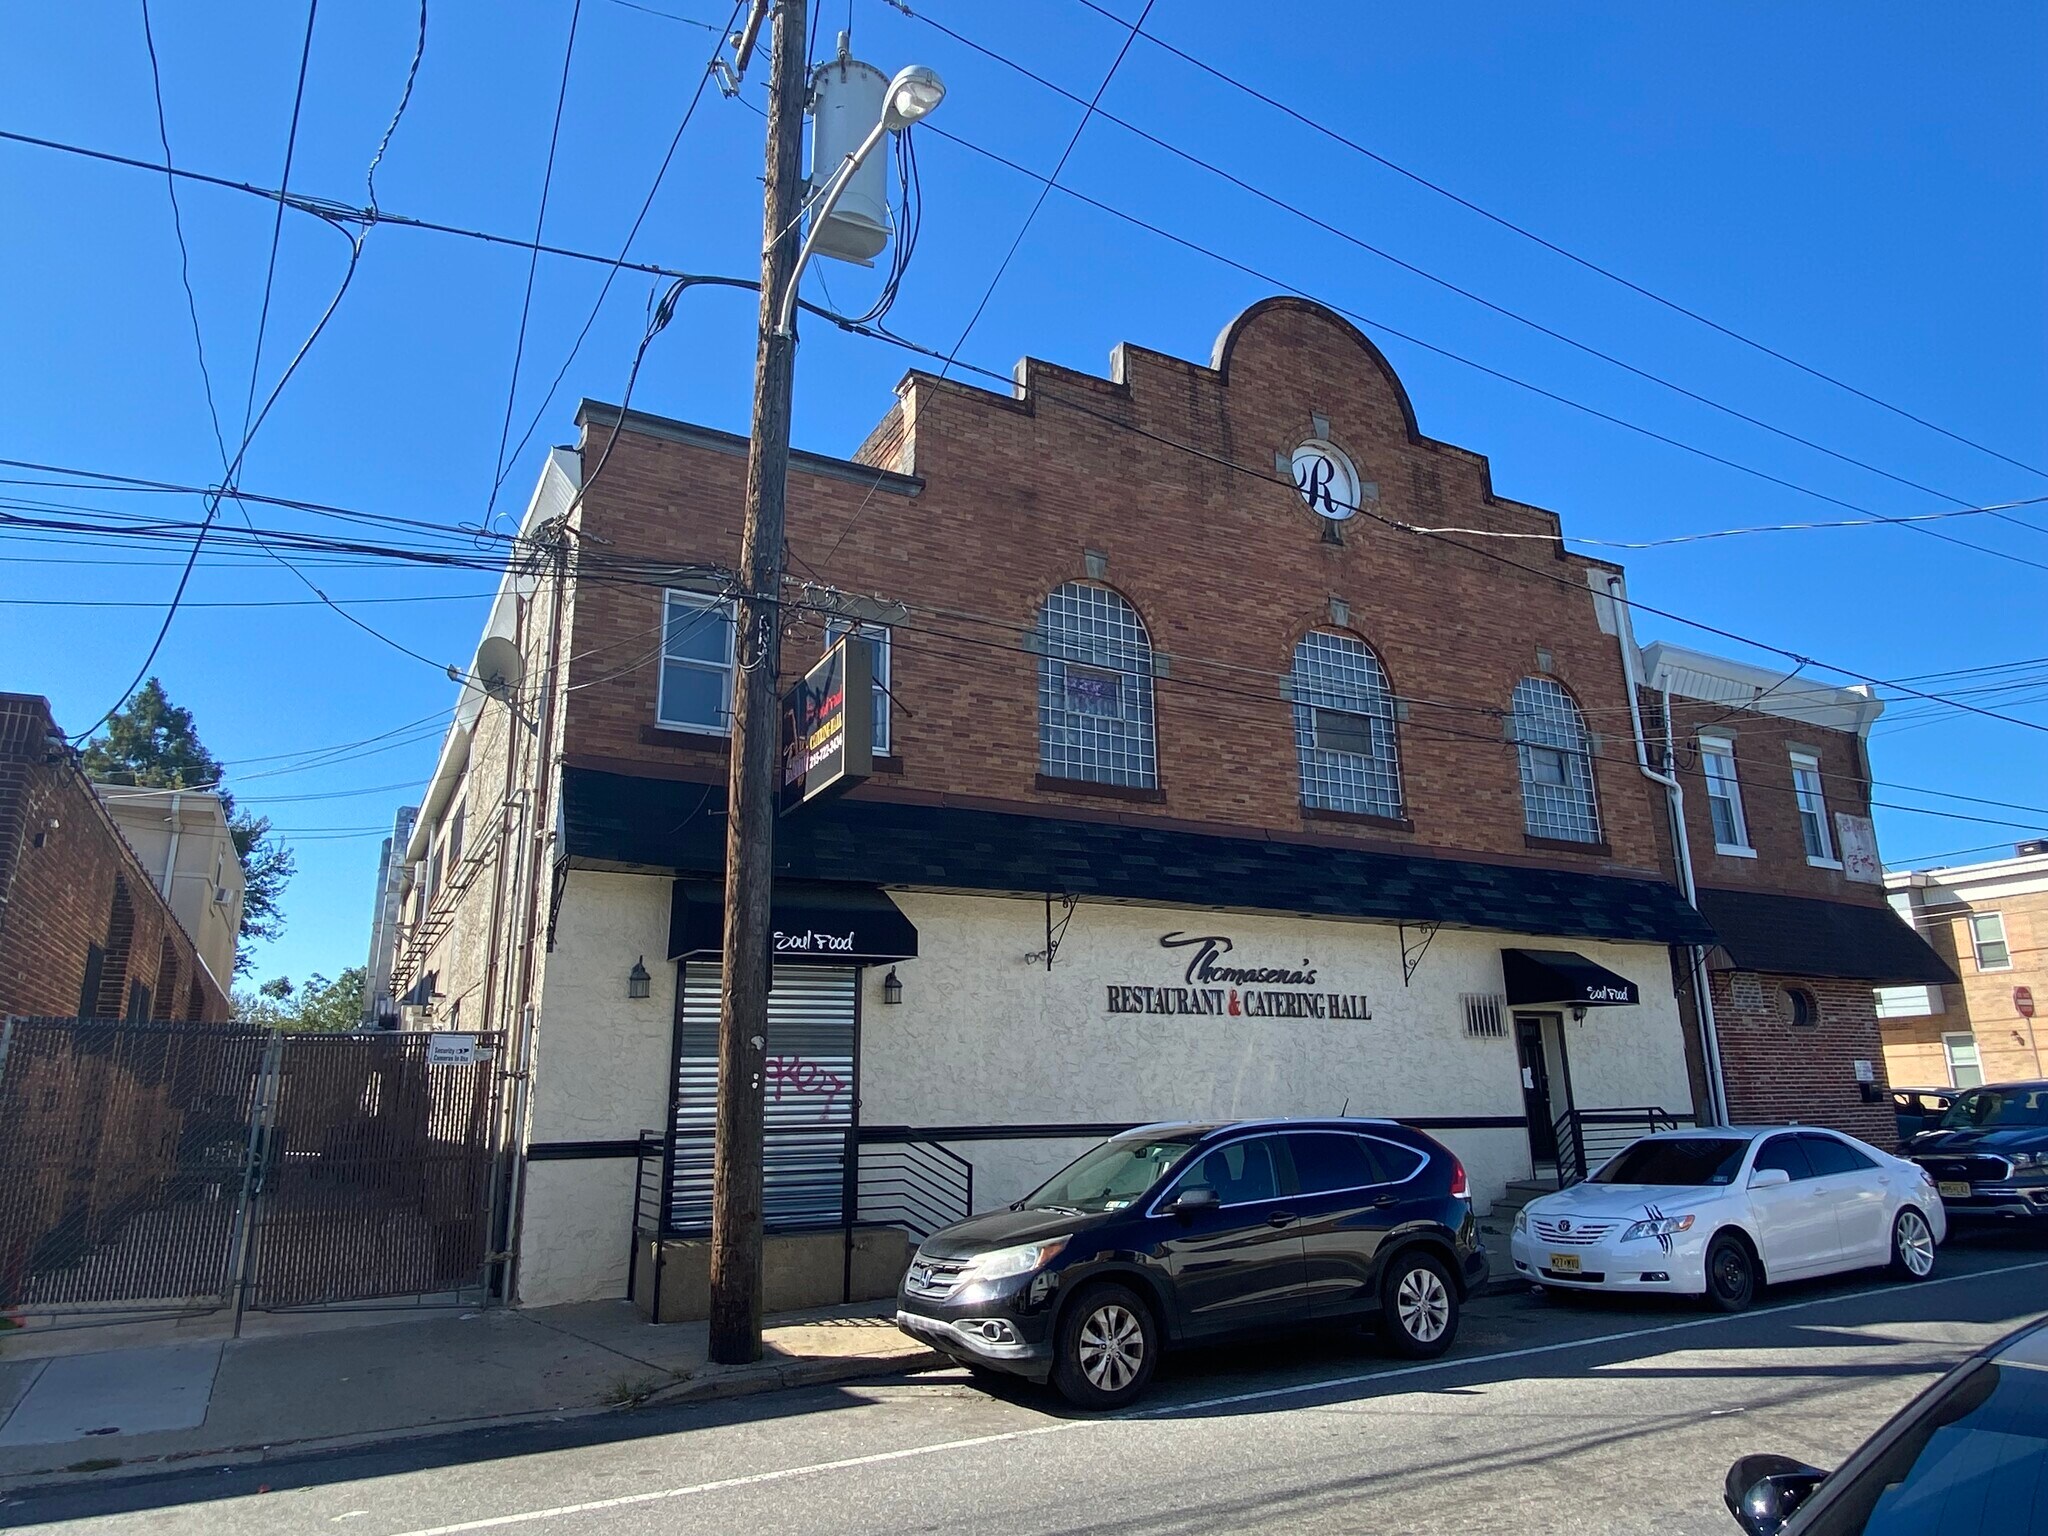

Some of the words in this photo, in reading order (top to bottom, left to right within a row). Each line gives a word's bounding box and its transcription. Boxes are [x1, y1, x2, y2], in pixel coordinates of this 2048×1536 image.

[1297, 455, 1340, 514] R
[773, 930, 812, 950] Soul
[813, 931, 855, 951] Food
[1160, 931, 1318, 985] Thomasena's
[1106, 985, 1225, 1016] RESTAURANT
[1228, 989, 1241, 1017] &
[1243, 991, 1325, 1019] CATERING
[1328, 994, 1372, 1020] HALL
[1587, 985, 1607, 1000] Soul
[1607, 986, 1628, 1001] Food
[435, 1047, 454, 1055] Security
